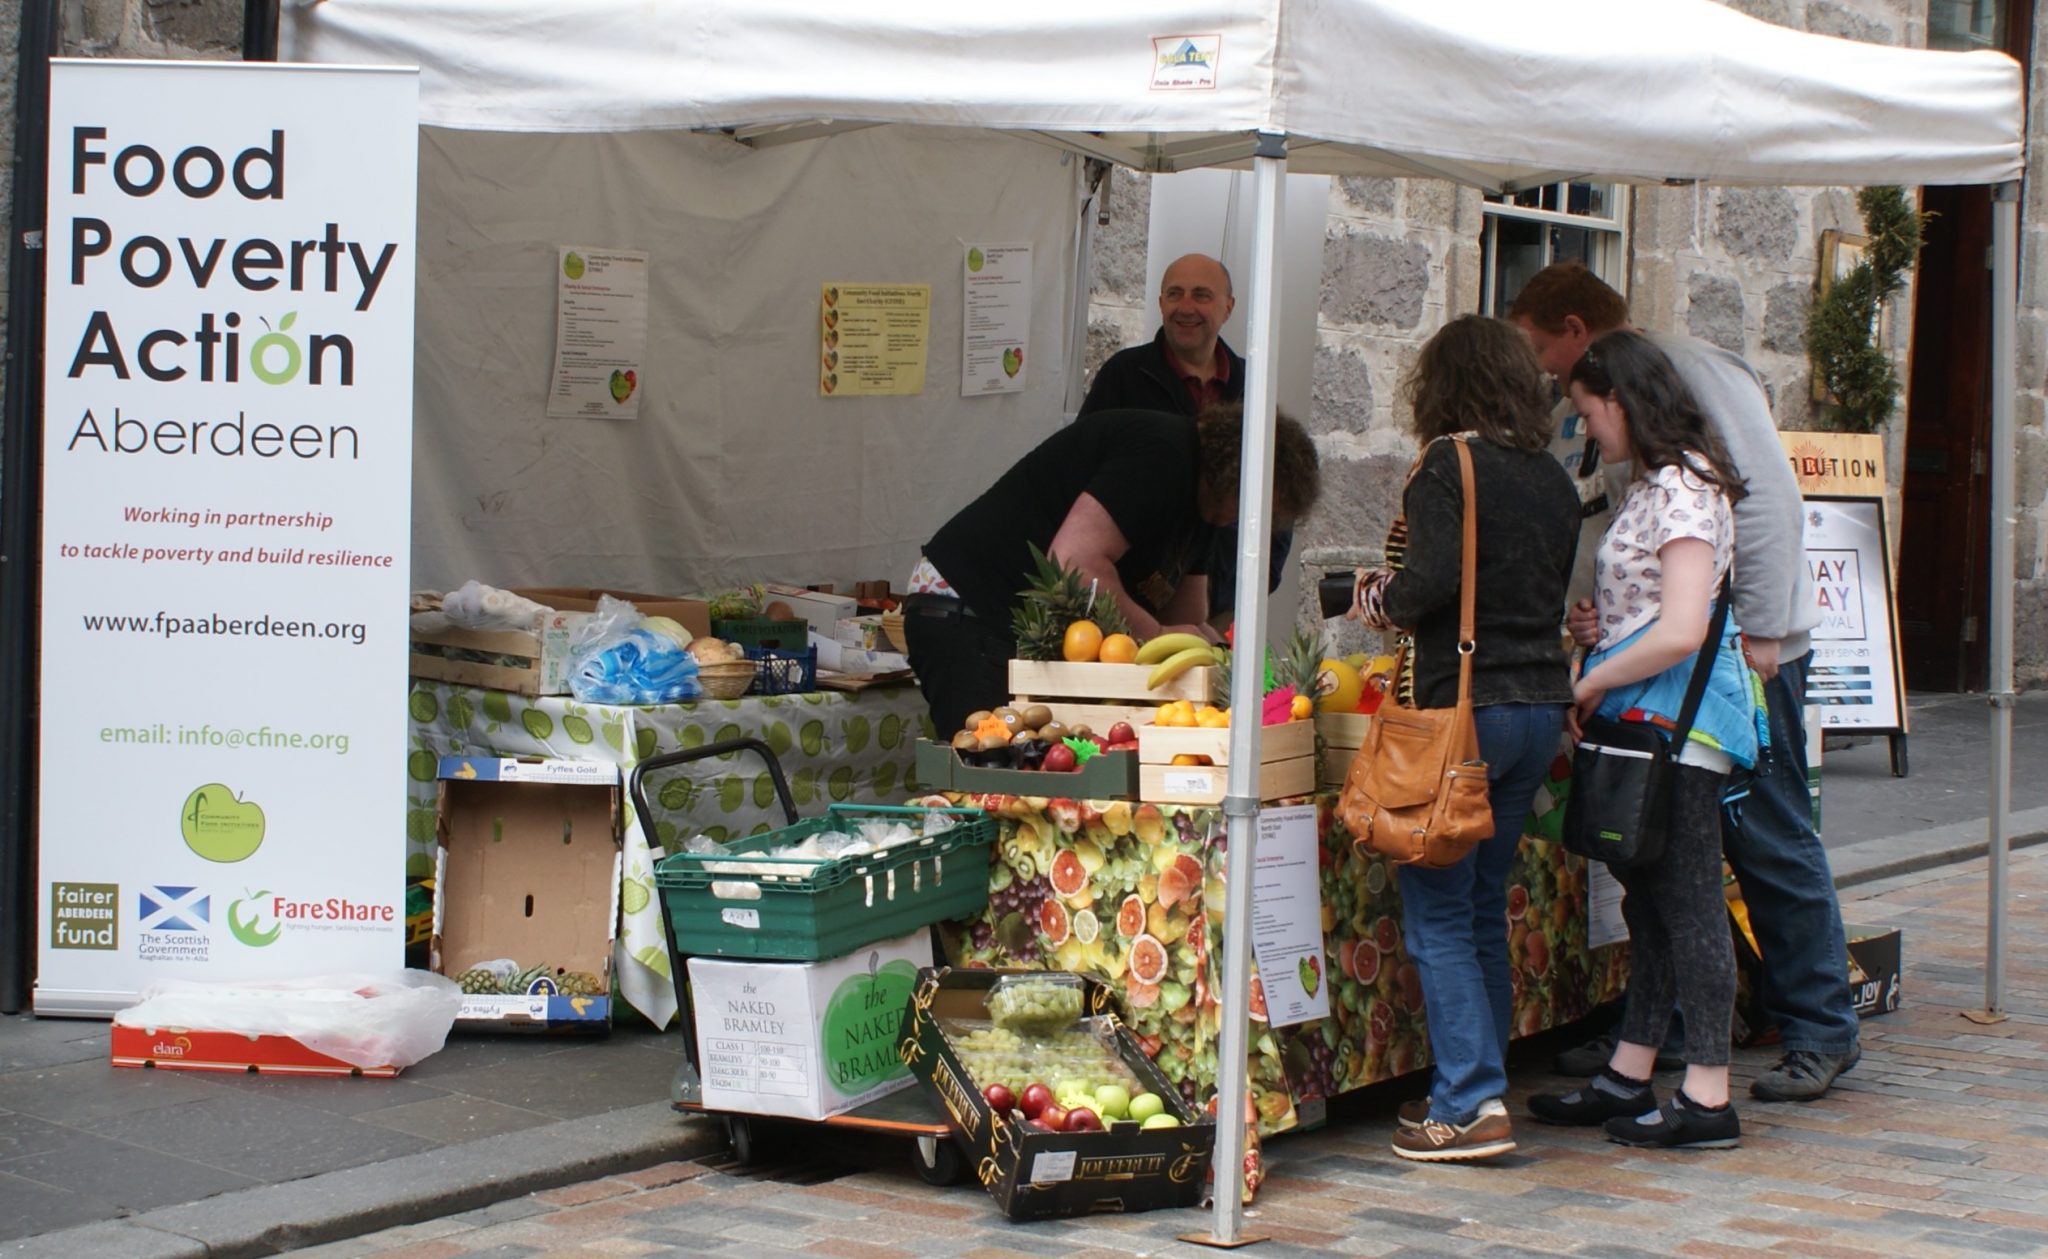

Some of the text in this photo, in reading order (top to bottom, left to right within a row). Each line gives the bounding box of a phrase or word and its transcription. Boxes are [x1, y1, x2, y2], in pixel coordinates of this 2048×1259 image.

[71, 125, 286, 201] Food
[70, 216, 399, 312] Poverty
[67, 311, 355, 386] Action
[67, 407, 359, 460] Aberdeen
[123, 506, 334, 532] Working in partnership
[60, 542, 394, 568] to tackle poverty and build resilience
[83, 611, 367, 645] www.fpaaberdeen.org
[100, 723, 350, 756] email: info@cfine.org
[547, 764, 598, 775] Fyffes Gold
[57, 885, 115, 905] fairer
[57, 906, 113, 920] ABERDEEN
[273, 897, 394, 922] FareShare
[56, 923, 114, 946] fund
[139, 933, 210, 945] The Scottish
[139, 943, 208, 955] Government
[742, 981, 757, 994] the
[864, 982, 888, 1011] the
[727, 999, 776, 1016] NAKED
[723, 1017, 785, 1035] BRAMLEY
[838, 1042, 902, 1085] BRAML
